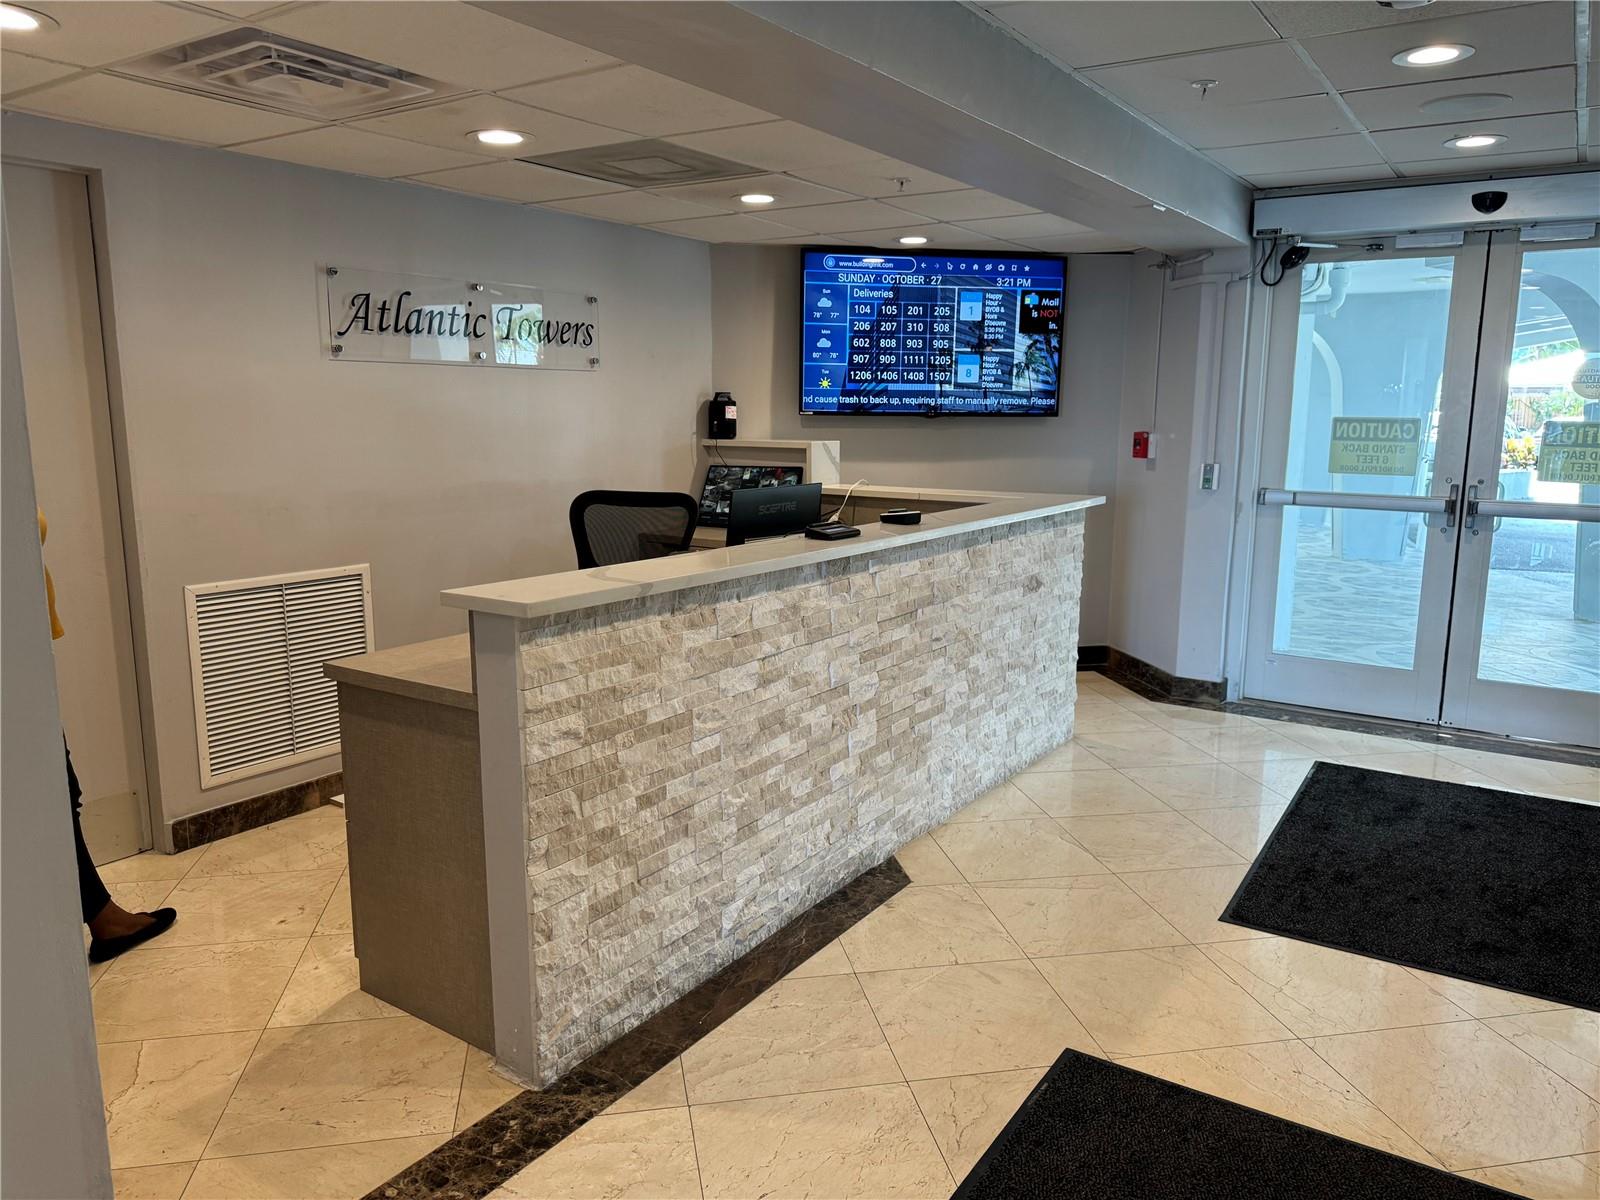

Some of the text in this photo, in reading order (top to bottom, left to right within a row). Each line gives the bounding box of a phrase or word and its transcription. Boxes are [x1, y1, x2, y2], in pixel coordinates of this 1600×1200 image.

[838, 274, 876, 283] SUNDAY
[882, 275, 924, 284] OCTOBER
[931, 276, 942, 285] 27
[996, 278, 1031, 287] 3:21 PM
[854, 288, 894, 298] Deliveries
[986, 292, 1003, 300] Happy
[1042, 298, 1059, 306] Mail
[854, 305, 950, 316] 104 105 201 205
[1032, 309, 1038, 317] is
[338, 291, 594, 346] Atlantic Towers
[854, 322, 950, 332] 206 207 310 508
[1049, 322, 1058, 330] in.
[853, 338, 949, 348] 602 808 903 905
[853, 355, 951, 364] 907 909 1111 1205
[850, 371, 950, 380] 1206 1406 1408 1507
[965, 368, 972, 378] 8
[840, 396, 859, 404] trash
[860, 396, 868, 404] to
[870, 396, 888, 404] back
[902, 396, 936, 406] requiring
[937, 396, 954, 405] staff
[965, 396, 998, 406] manually
[1030, 396, 1055, 405] Please
[758, 502, 798, 514] SCEPTRE
